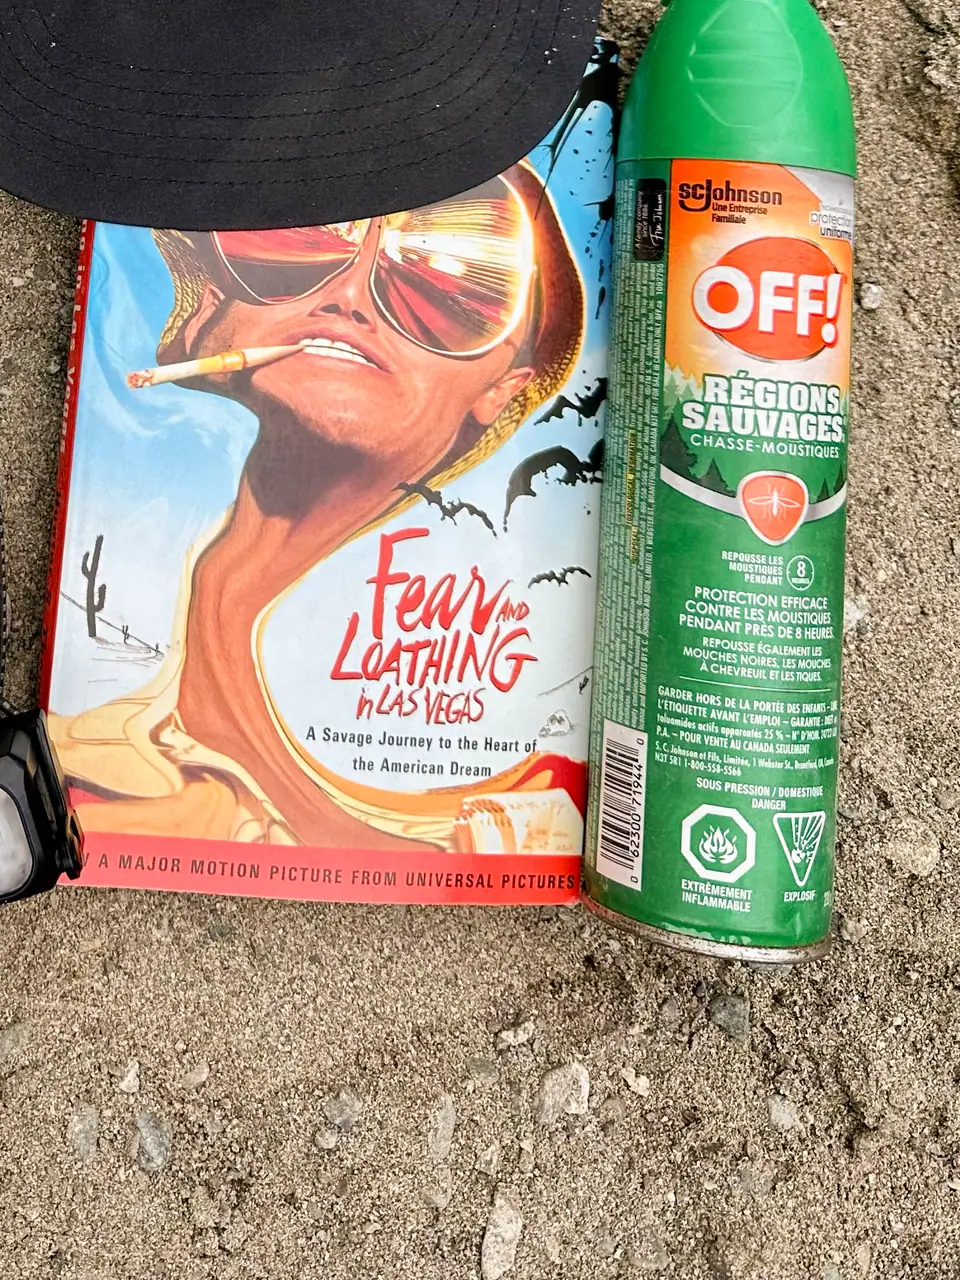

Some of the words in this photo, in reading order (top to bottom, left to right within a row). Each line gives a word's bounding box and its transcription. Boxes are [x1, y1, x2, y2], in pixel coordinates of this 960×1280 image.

[712, 202, 728, 211] Une
[729, 203, 768, 215] Entreprise
[693, 265, 843, 345] OFF!
[703, 370, 841, 414] RÉGIONS
[682, 402, 842, 442] SAUVAGES
[690, 433, 840, 459] CHASSE-MOUSTIQUES
[722, 551, 767, 565] REPOUSSE
[768, 556, 783, 565] LES
[729, 562, 783, 575] MOUSTIQUES
[797, 561, 806, 577] 8
[366, 527, 514, 640] Fear
[495, 596, 530, 623] AND
[745, 574, 783, 585] PENDANT
[695, 586, 778, 607] PROTECTION
[781, 596, 828, 609] EFFICACE
[685, 600, 741, 619] CONTRE
[744, 607, 765, 621] LES
[768, 611, 831, 625] MOUSTIQUES
[680, 614, 741, 634] PENDANT
[745, 620, 774, 637] PRÈS
[778, 626, 792, 638] DE
[795, 627, 802, 639] 8
[330, 611, 538, 693] LOATHING
[683, 646, 737, 663] MOUCHES
[783, 658, 796, 668] LES
[798, 659, 831, 668] MOUCHES
[702, 637, 755, 652] REPOUSSE
[757, 641, 810, 656] ÉGALEMENT
[812, 647, 822, 656] LES
[700, 659, 708, 671] À
[711, 663, 767, 679] CHEVREUIL
[770, 670, 779, 680] ET
[781, 671, 794, 680] LES
[355, 687, 374, 720] in
[376, 684, 423, 717] LAS
[425, 686, 487, 725] VEGAS
[658, 686, 692, 701] GARDER
[696, 693, 722, 706] HORS
[725, 697, 736, 708] DE
[739, 699, 751, 710] LA
[753, 700, 785, 713] PORTÉE
[787, 703, 800, 713] DES
[710, 709, 740, 722] AVANT
[743, 713, 780, 726] L'EMPLOI
[306, 726, 317, 741] A
[323, 726, 373, 747] Savage
[379, 730, 433, 751] Journey
[439, 735, 452, 750] to
[457, 735, 478, 751] the
[484, 736, 520, 752] Heart
[524, 739, 538, 753] of
[680, 731, 701, 744] POUR
[704, 735, 728, 748] VENTE
[730, 740, 741, 750] AU
[743, 741, 774, 754] CANADA
[764, 729, 773, 739] 25
[352, 756, 375, 771] the
[380, 758, 445, 775] American
[450, 761, 492, 777] Dream
[684, 759, 742, 776] 1-800-558-5566
[632, 764, 644, 807] 71944
[696, 778, 722, 790] SOUS
[725, 782, 770, 797] PRESSION
[778, 786, 823, 797] DOMESTIQUE
[752, 798, 786, 810] DANGER
[630, 813, 641, 858] 62300
[98, 854, 109, 868] A
[118, 855, 182, 873] MAJOR
[190, 859, 261, 879] MOTION
[269, 864, 343, 884] PICTURE
[352, 869, 398, 887] FROM
[405, 871, 494, 890] UNIVERSAL
[501, 873, 575, 890] PICTURES
[681, 878, 752, 900] EXTRÊMEMENT
[784, 891, 815, 902] EXPLOSIF
[682, 891, 751, 912] INFLAMMABLE
